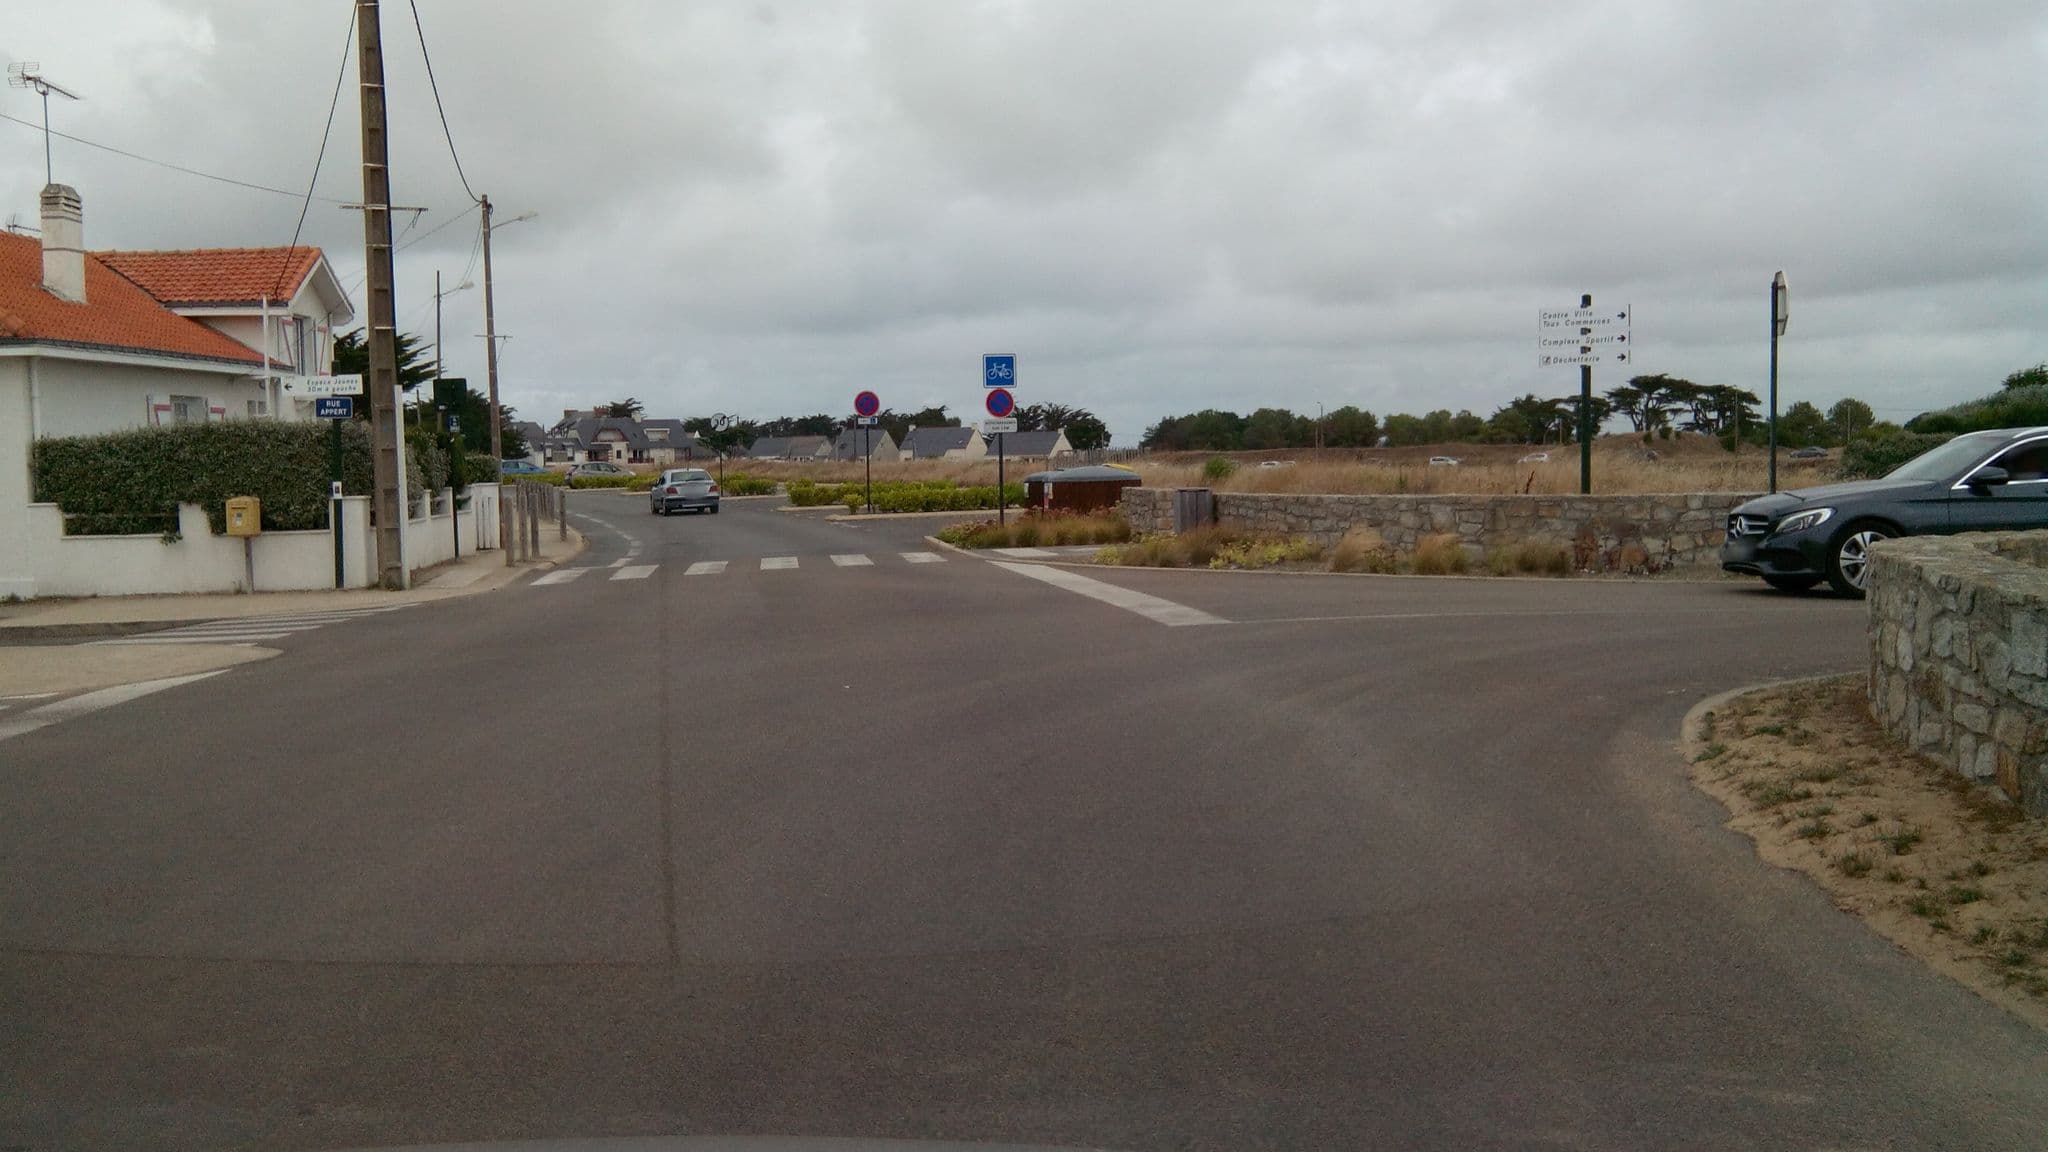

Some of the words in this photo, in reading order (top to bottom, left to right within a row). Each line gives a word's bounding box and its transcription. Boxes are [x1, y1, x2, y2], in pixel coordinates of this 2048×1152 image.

[1542, 312, 1568, 320] Centre
[1574, 310, 1593, 318] Ville
[1543, 320, 1560, 328] Tous
[1565, 318, 1611, 327] Commerces
[1542, 338, 1580, 347] Complexe
[1585, 336, 1614, 345] Sportif
[307, 379, 331, 387] Espace
[334, 378, 358, 386] Jeunes
[326, 400, 341, 408] RUE
[320, 408, 347, 416] APPERT
